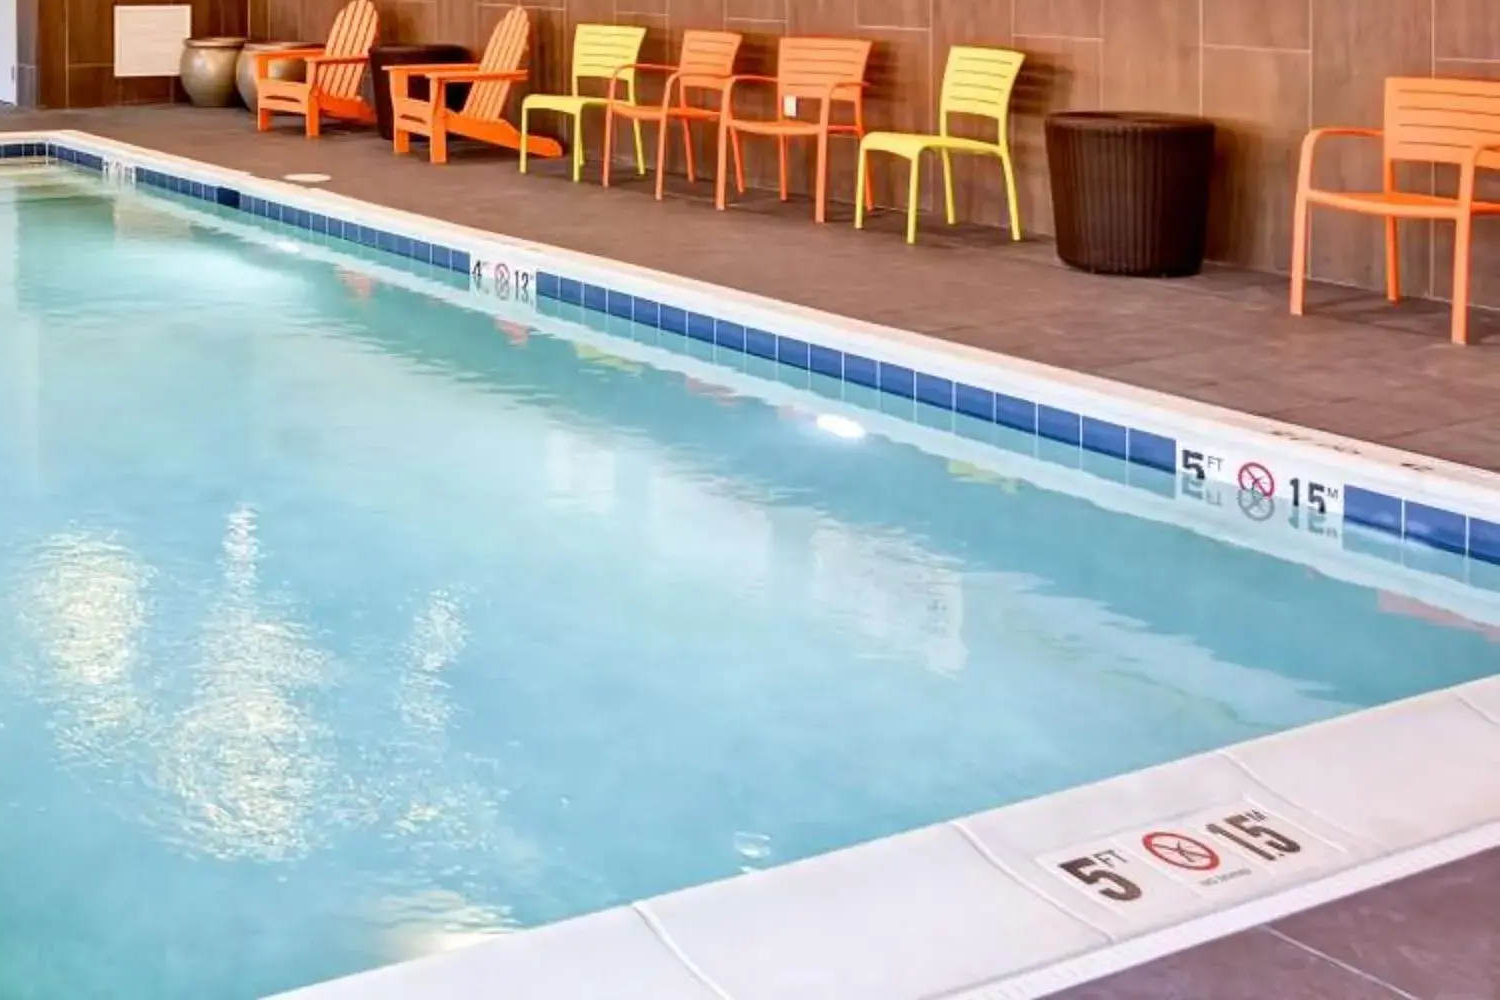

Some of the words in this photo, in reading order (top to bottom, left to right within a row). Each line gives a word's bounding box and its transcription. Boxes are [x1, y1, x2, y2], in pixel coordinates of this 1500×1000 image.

[1182, 449, 1205, 480] 5
[1207, 455, 1225, 472] FT
[1092, 849, 1127, 868] FT
[1058, 857, 1142, 901] 5
